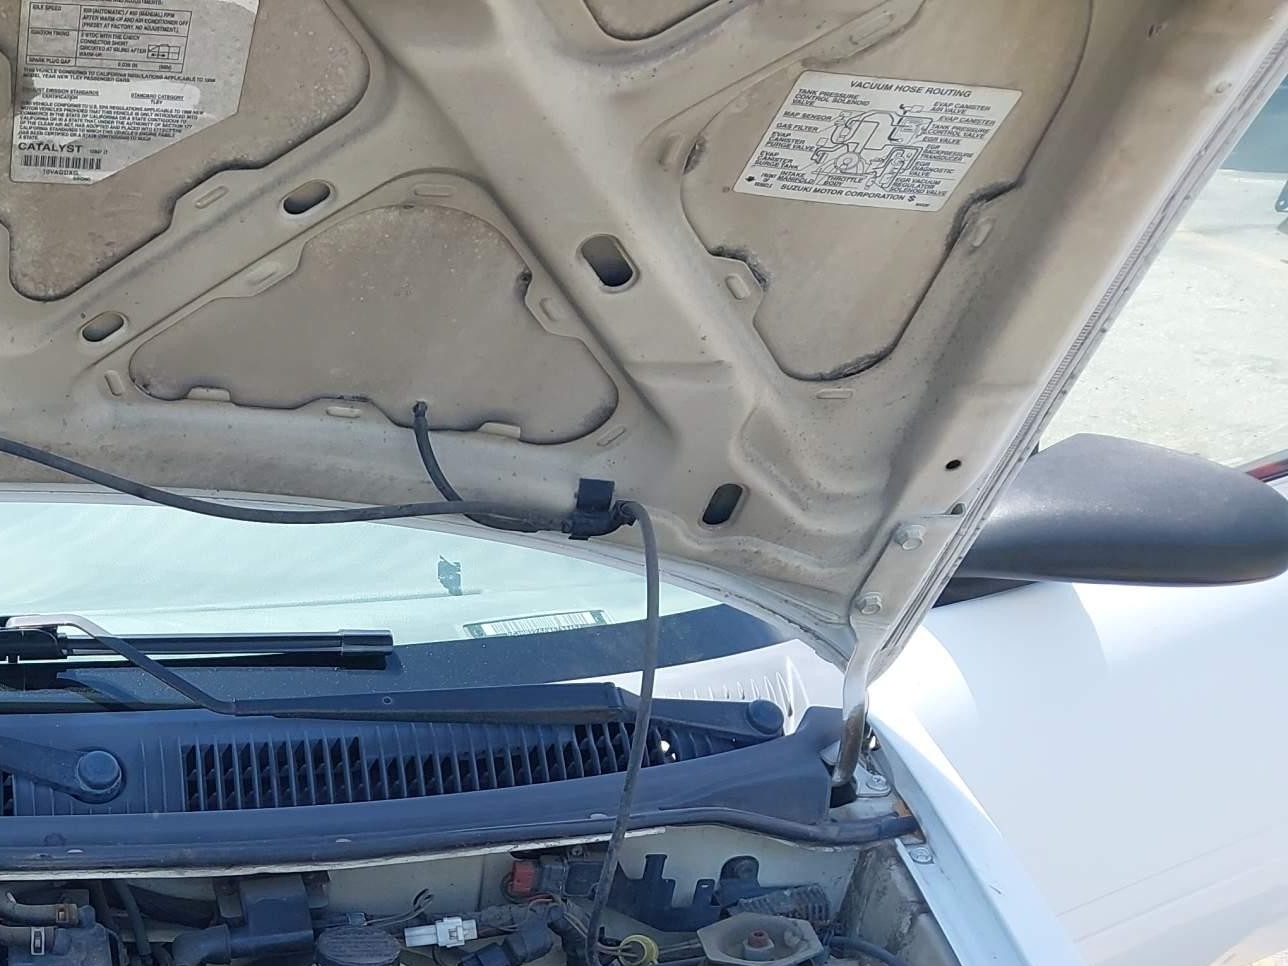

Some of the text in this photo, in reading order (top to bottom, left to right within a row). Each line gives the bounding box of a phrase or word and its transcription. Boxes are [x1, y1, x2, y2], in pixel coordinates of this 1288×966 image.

[818, 90, 860, 99] PRESSURE
[850, 80, 972, 97] VACUUM HOSE ROUTING
[795, 94, 870, 106] CONTROL SOLENOID
[18, 142, 83, 152] CATALYST
[780, 184, 812, 192] SUZUKI
[812, 187, 844, 196] MOTOR
[844, 191, 906, 200] CORPORATION
